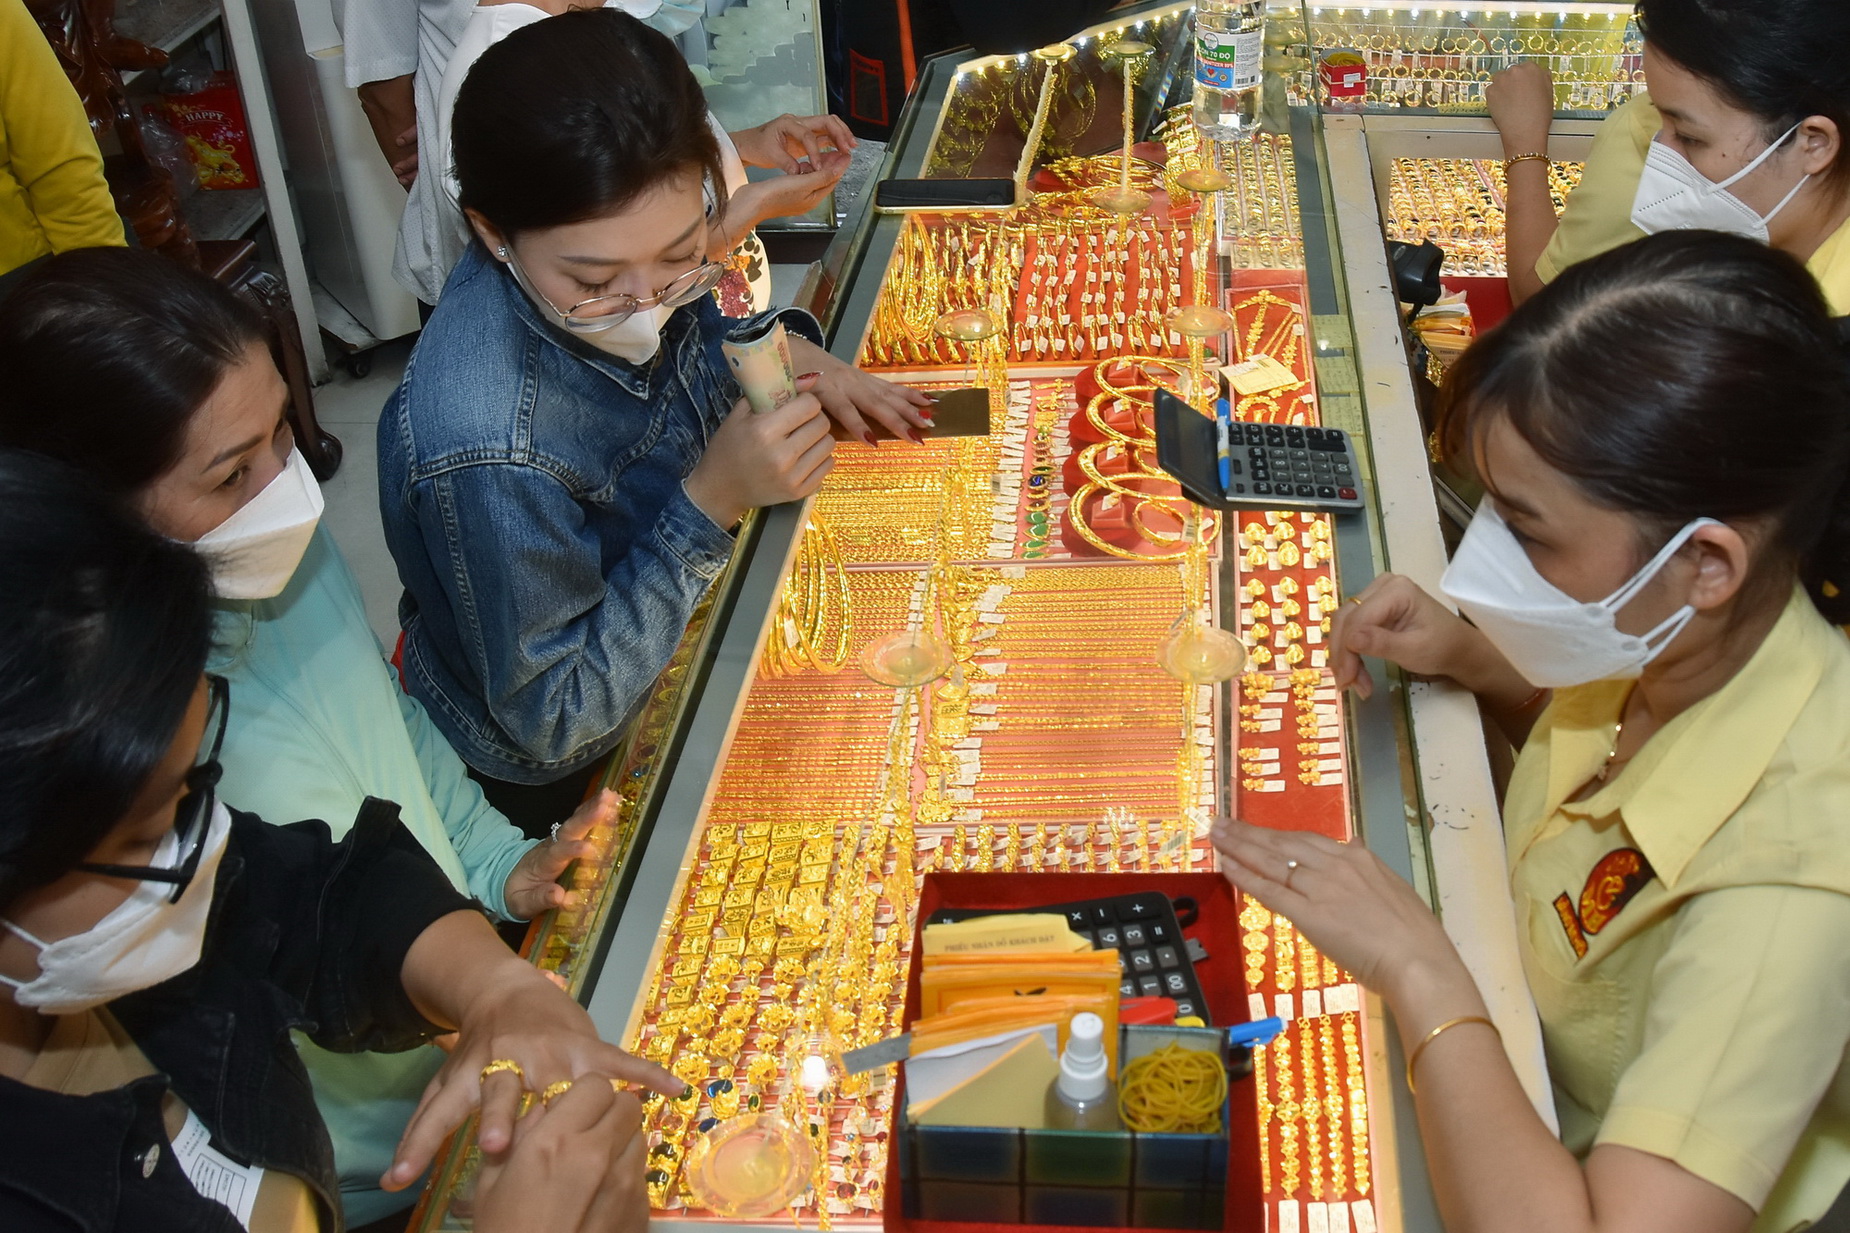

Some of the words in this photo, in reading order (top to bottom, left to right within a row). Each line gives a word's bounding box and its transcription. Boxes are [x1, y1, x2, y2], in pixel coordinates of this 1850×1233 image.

[185, 111, 224, 122] HAPPY
[1103, 933, 1118, 943] 6
[1126, 930, 1142, 939] 3
[1135, 955, 1151, 965] 2
[1143, 982, 1158, 990] 1
[1168, 974, 1184, 990] 00
[1119, 985, 1132, 994] 4
[1178, 1003, 1192, 1014] 0
